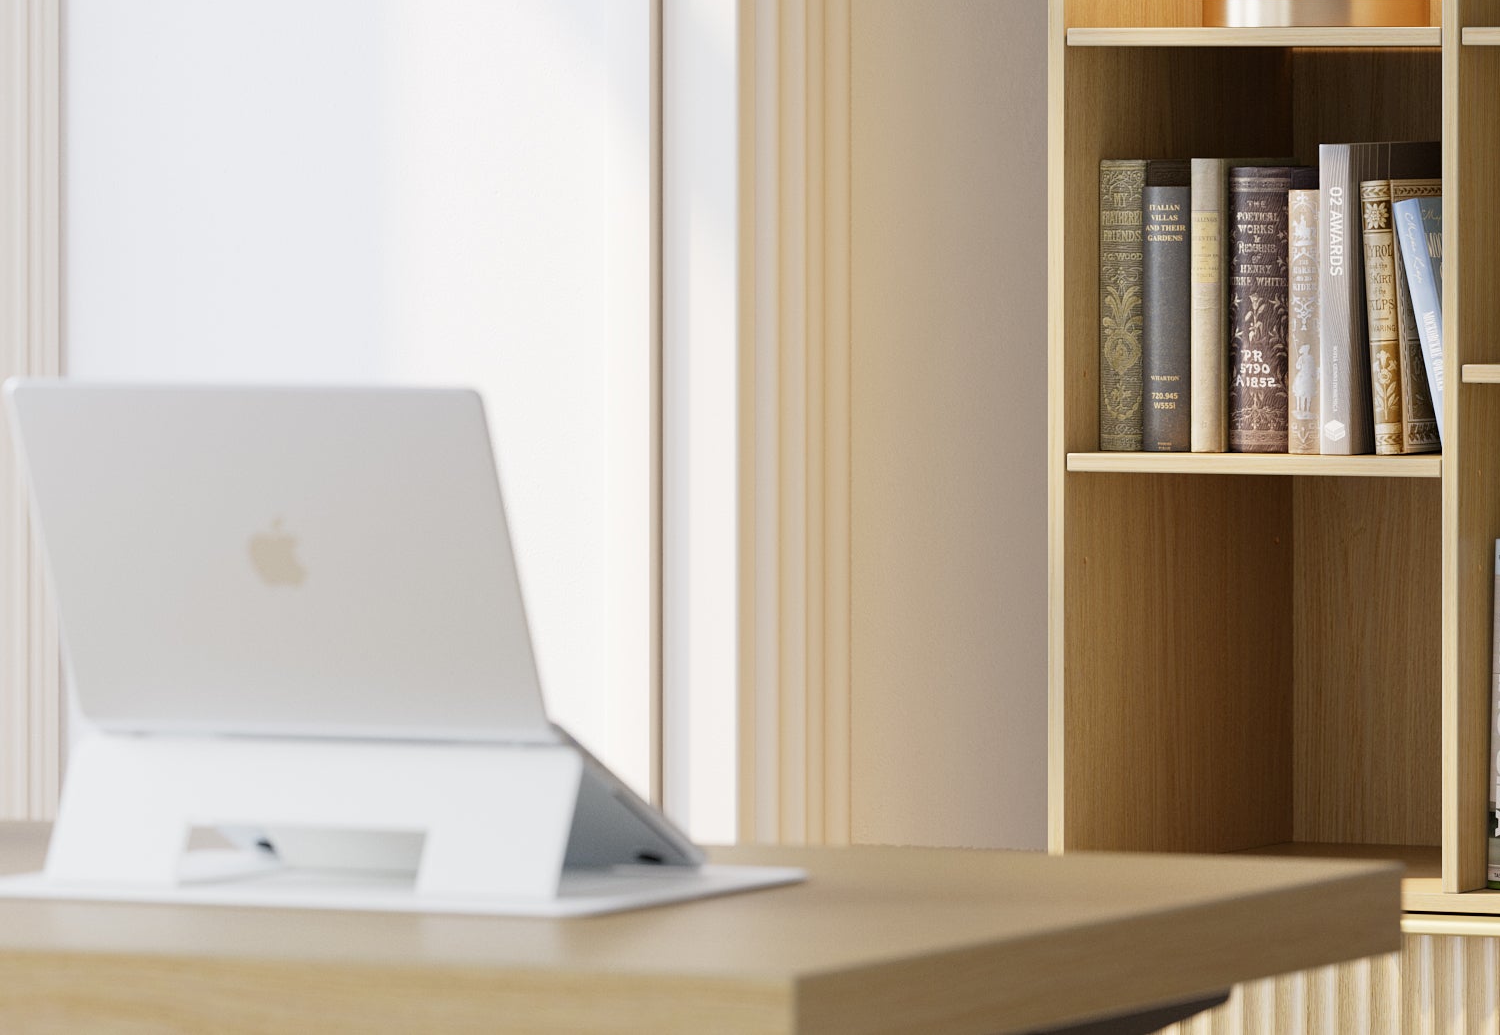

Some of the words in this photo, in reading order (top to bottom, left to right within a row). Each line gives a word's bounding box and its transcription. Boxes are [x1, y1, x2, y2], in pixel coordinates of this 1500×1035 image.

[1237, 212, 1279, 221] POETICAL
[1237, 225, 1274, 234] WORKS
[1330, 211, 1343, 276] AWARDS
[1240, 265, 1272, 274] HENRY
[1241, 350, 1263, 362] PR
[1240, 364, 1270, 374] 5790
[1152, 392, 1178, 400] 720.945
